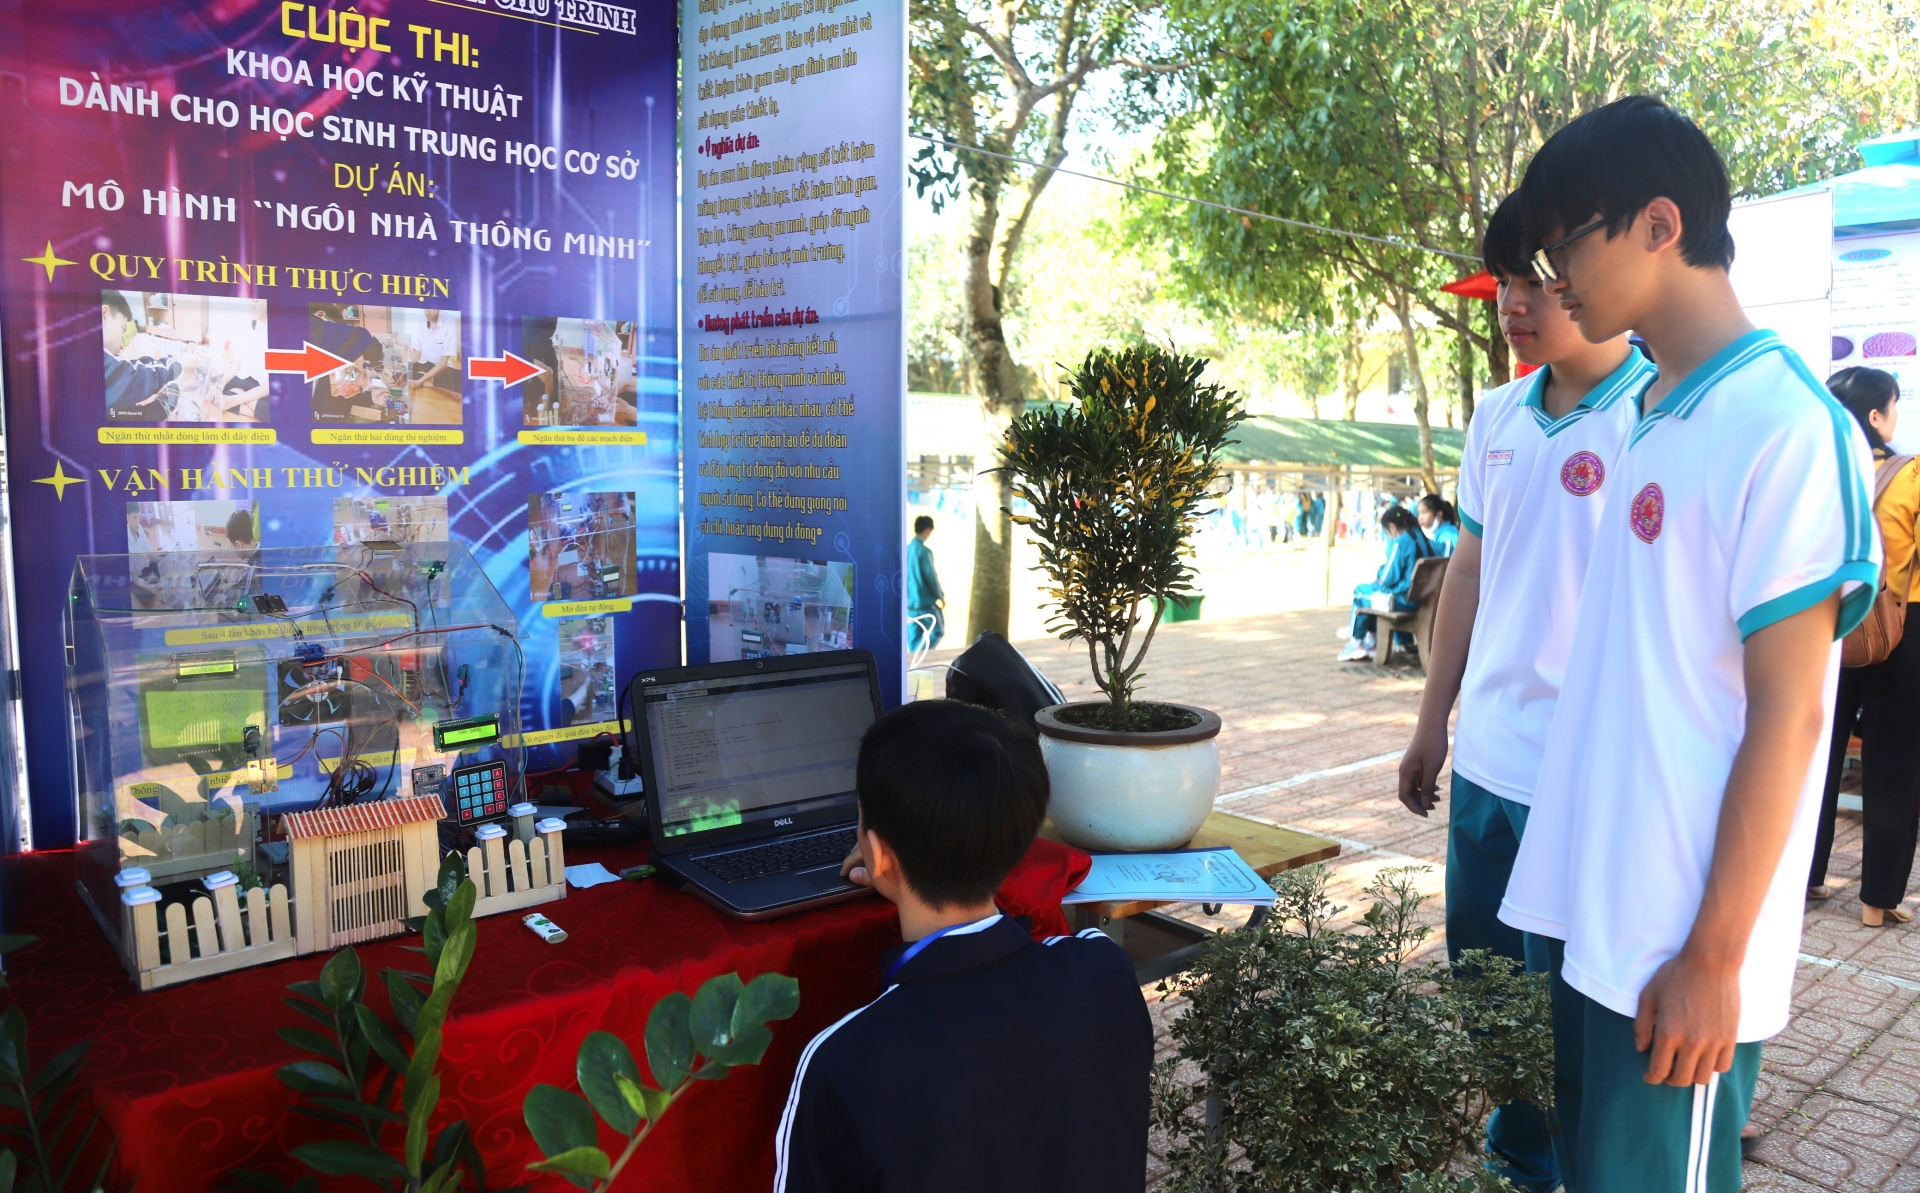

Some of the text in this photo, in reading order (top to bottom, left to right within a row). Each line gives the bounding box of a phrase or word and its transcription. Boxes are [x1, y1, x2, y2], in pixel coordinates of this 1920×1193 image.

[281, 1, 479, 68] CUỘC THI:
[555, 0, 636, 35] TRINH
[227, 48, 522, 121] KHOA HỌC KỸ THUẬT
[59, 72, 640, 180] DÀNH CHO HỌC SINH TRUNG HỌC CƠ SỞ
[334, 162, 434, 198] DỰ ÁN:
[62, 180, 125, 211] MÔ
[143, 186, 236, 222] HÌNH
[371, 212, 438, 241] NHÀ
[449, 220, 551, 252] THÔNG
[89, 252, 450, 302] QUY TRÌNH THỰC HIỆN
[370, 433, 382, 441] hai
[98, 461, 471, 496] VẬN HÀNH THỬ NGHIỆM
[774, 817, 793, 827] DELL
